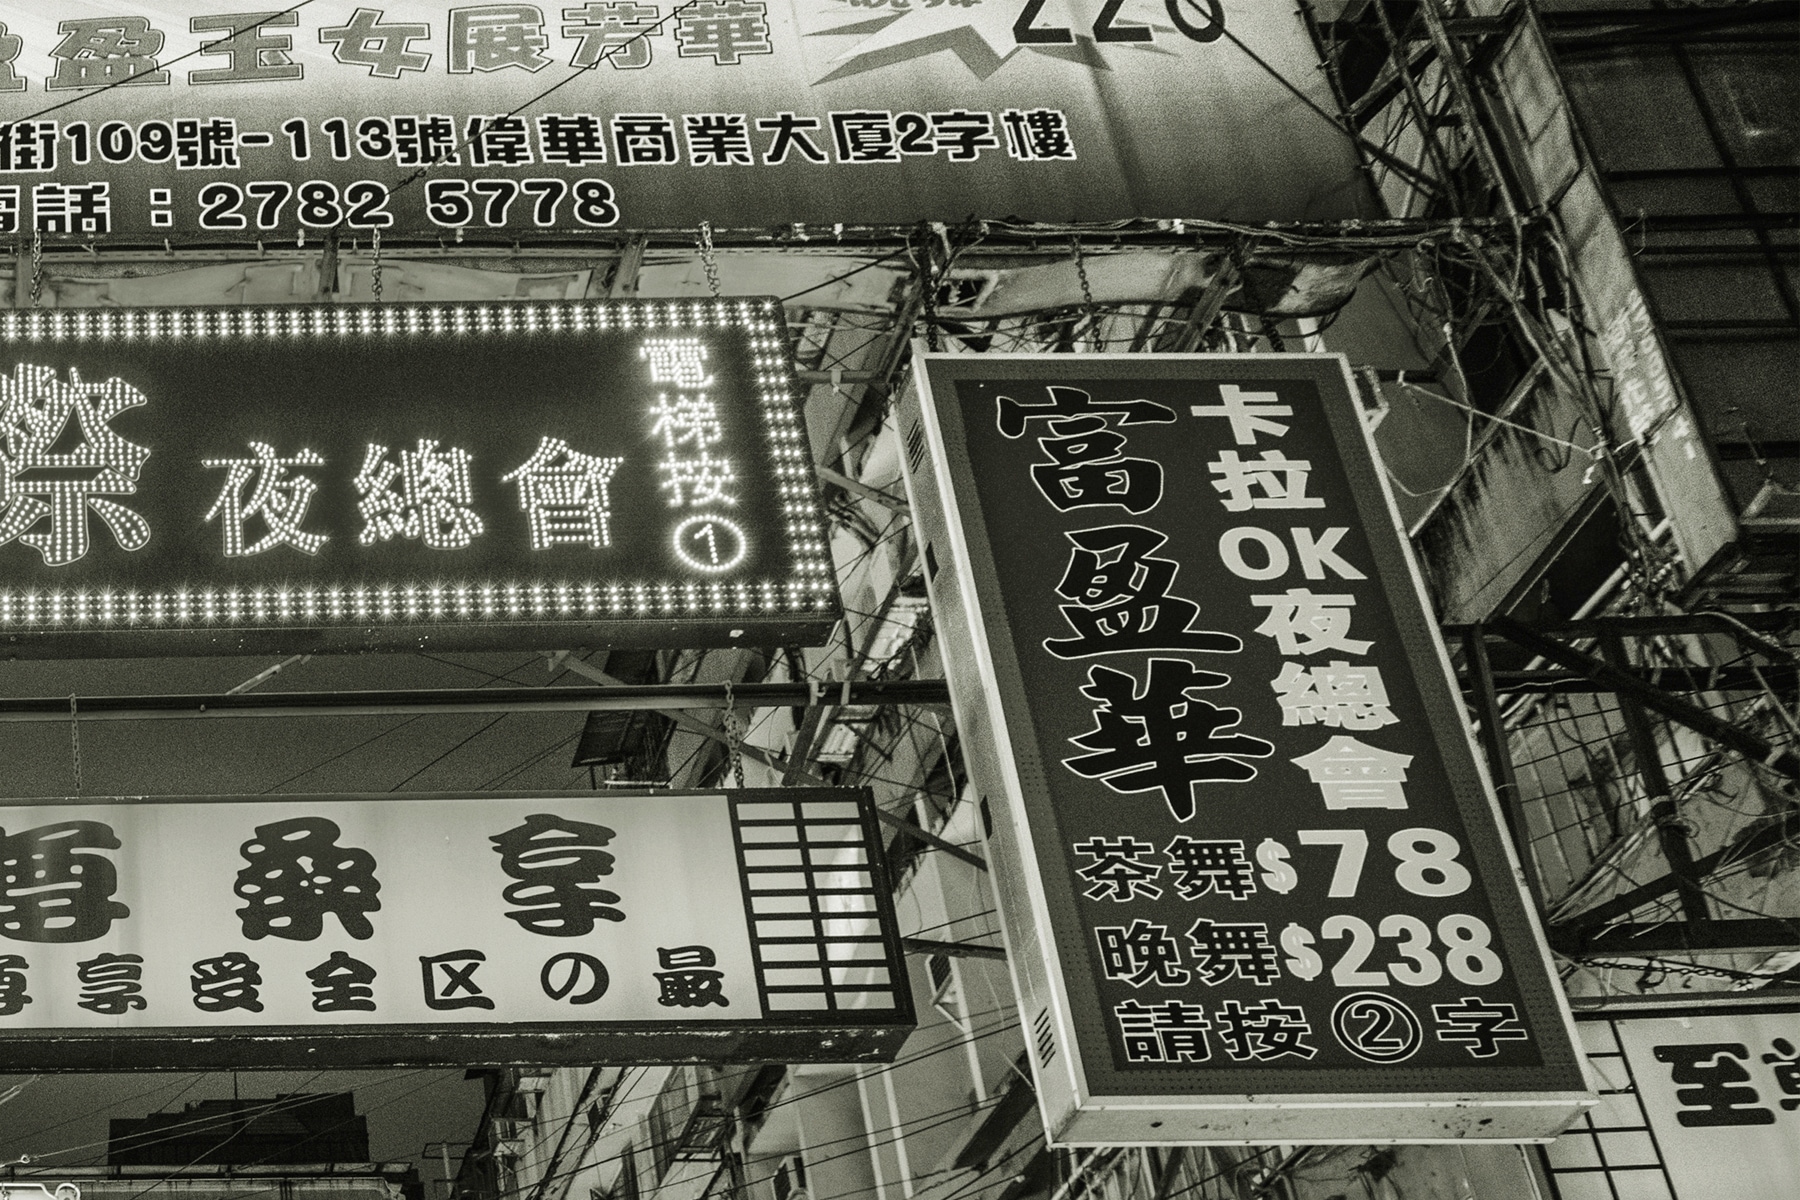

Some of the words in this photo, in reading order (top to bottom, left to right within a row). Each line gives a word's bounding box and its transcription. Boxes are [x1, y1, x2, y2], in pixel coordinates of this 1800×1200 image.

[199, 180, 393, 230] 2782
[425, 177, 620, 227] 5778
[994, 385, 1275, 823] 富盈華
